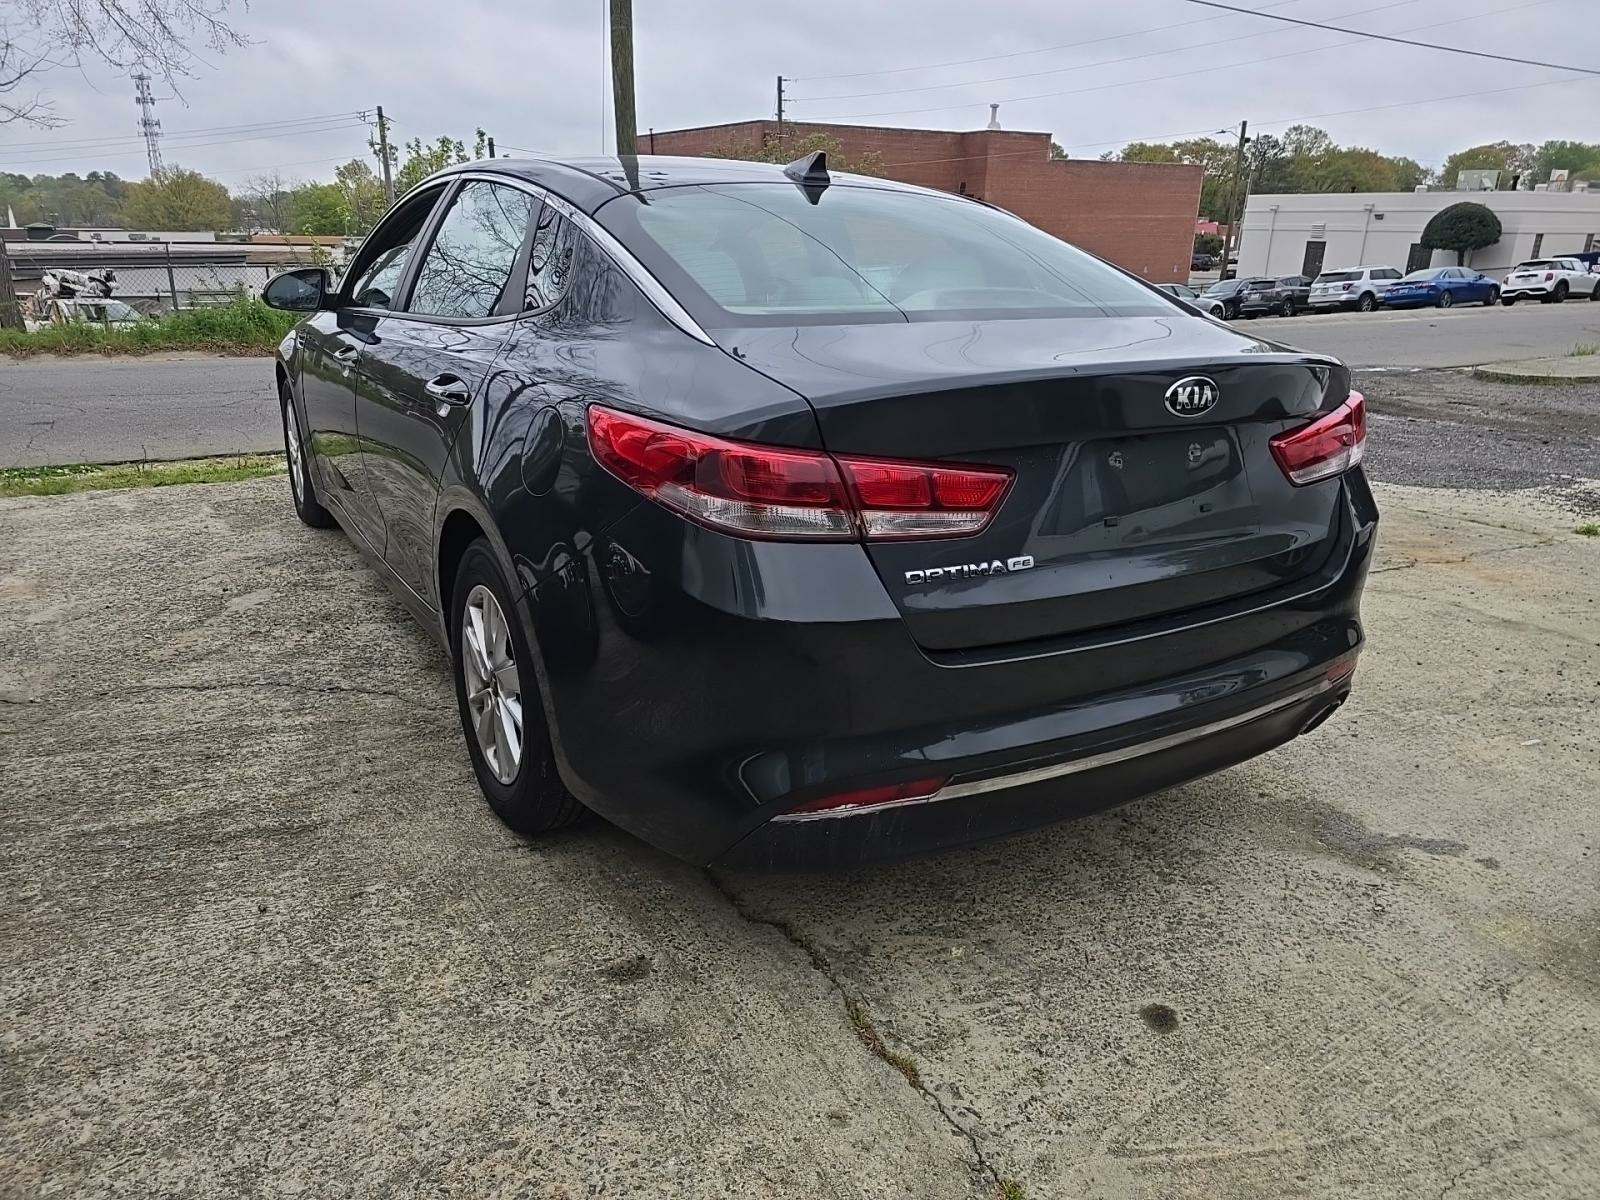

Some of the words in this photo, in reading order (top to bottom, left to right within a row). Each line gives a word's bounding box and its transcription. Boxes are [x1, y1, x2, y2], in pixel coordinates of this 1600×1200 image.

[1176, 385, 1213, 410] KIA
[904, 559, 1007, 585] OPTIMA
[1011, 558, 1032, 569] FE
